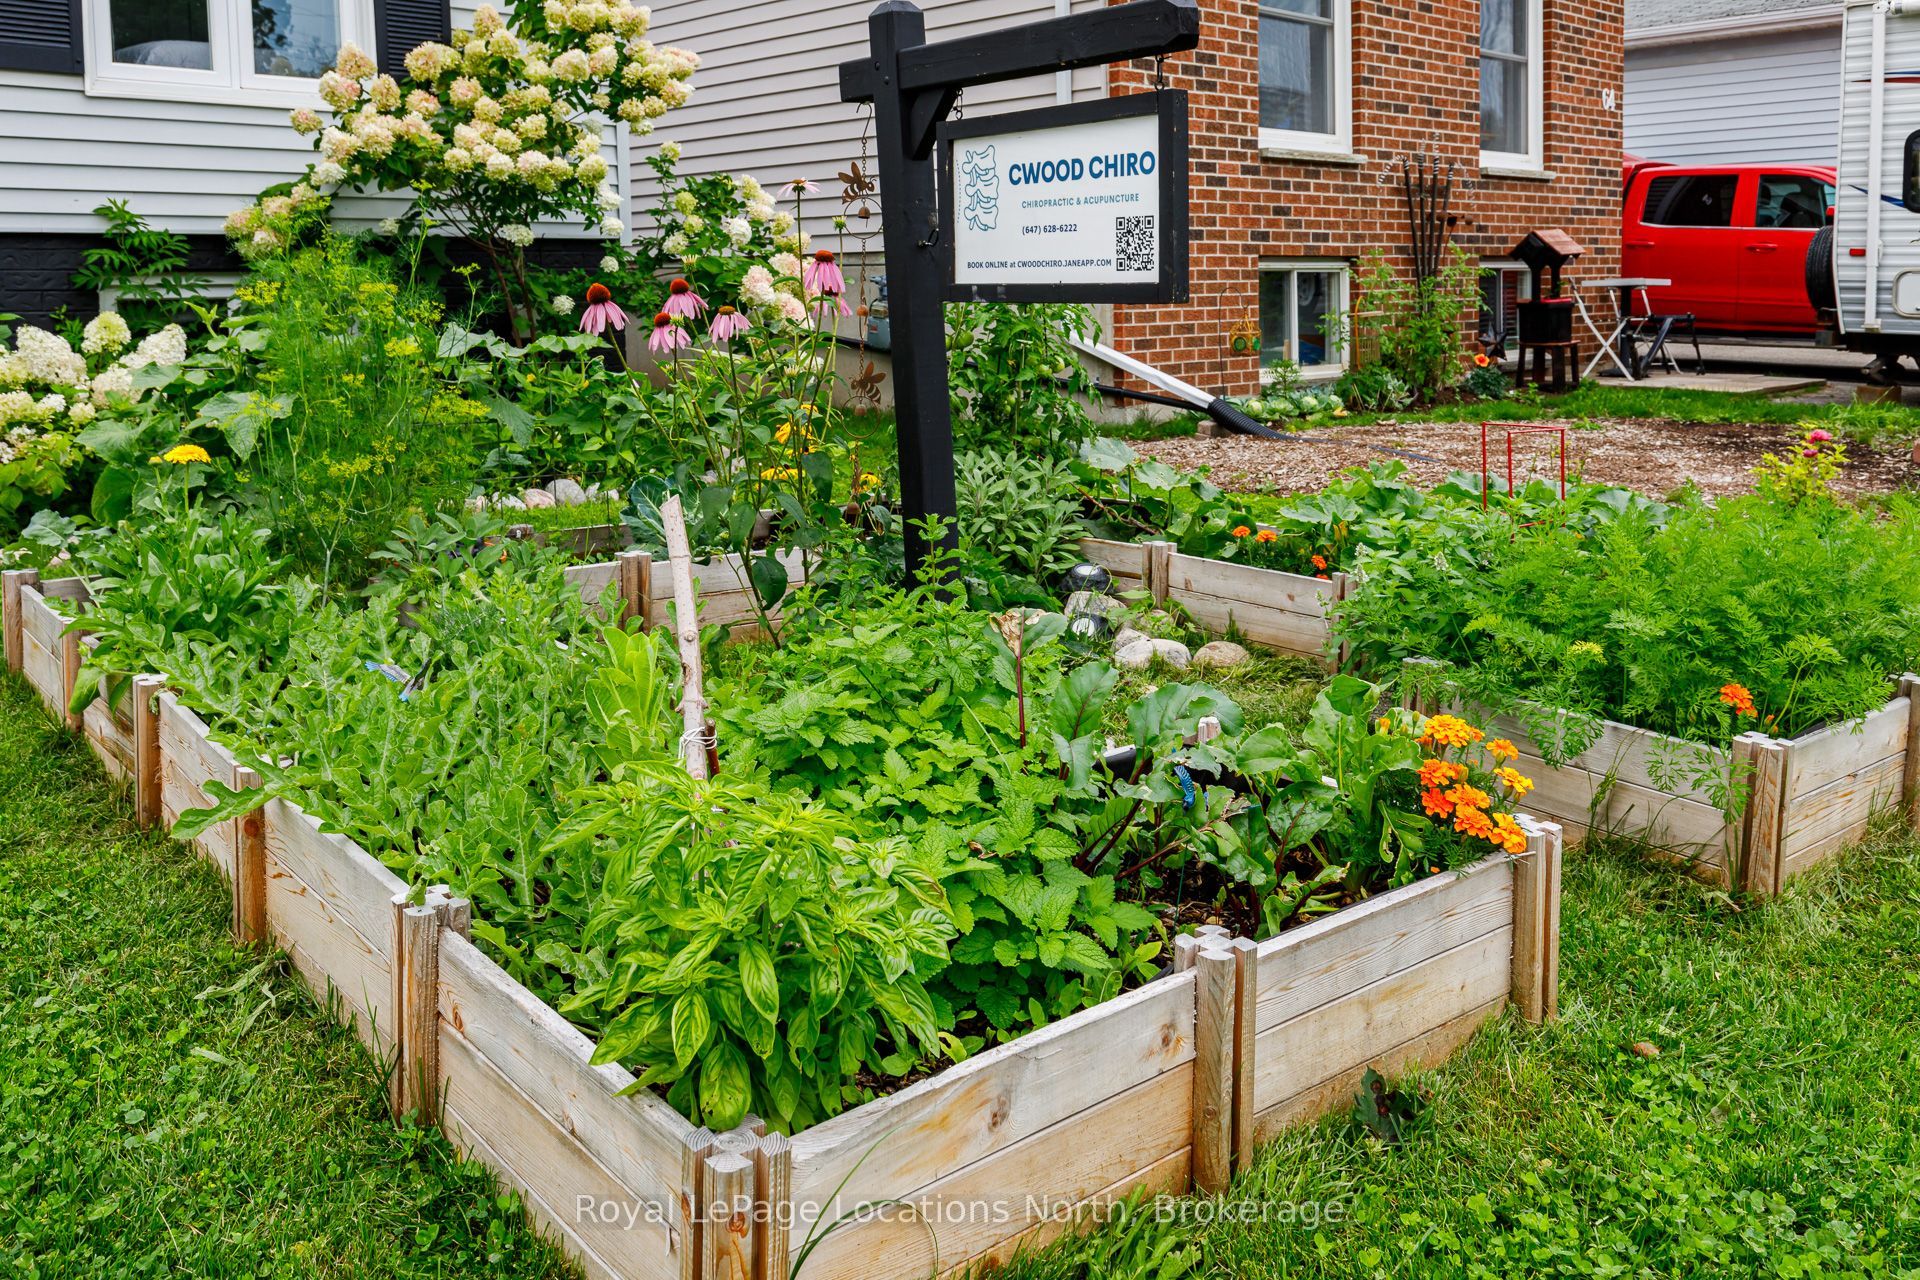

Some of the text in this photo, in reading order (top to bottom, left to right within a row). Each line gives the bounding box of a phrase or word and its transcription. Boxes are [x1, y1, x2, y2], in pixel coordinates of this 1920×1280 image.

[1008, 151, 1156, 186] CWOOD CHIRO
[1022, 193, 1140, 209] CHIROPRACTIC & ACUPUNCTURE
[1022, 224, 1078, 236] (647) 628-6222
[967, 261, 983, 269] BOOK
[985, 261, 1008, 269] ONLINE
[1017, 259, 1112, 268] CWOODCHIRO.JANEAPP.COM
